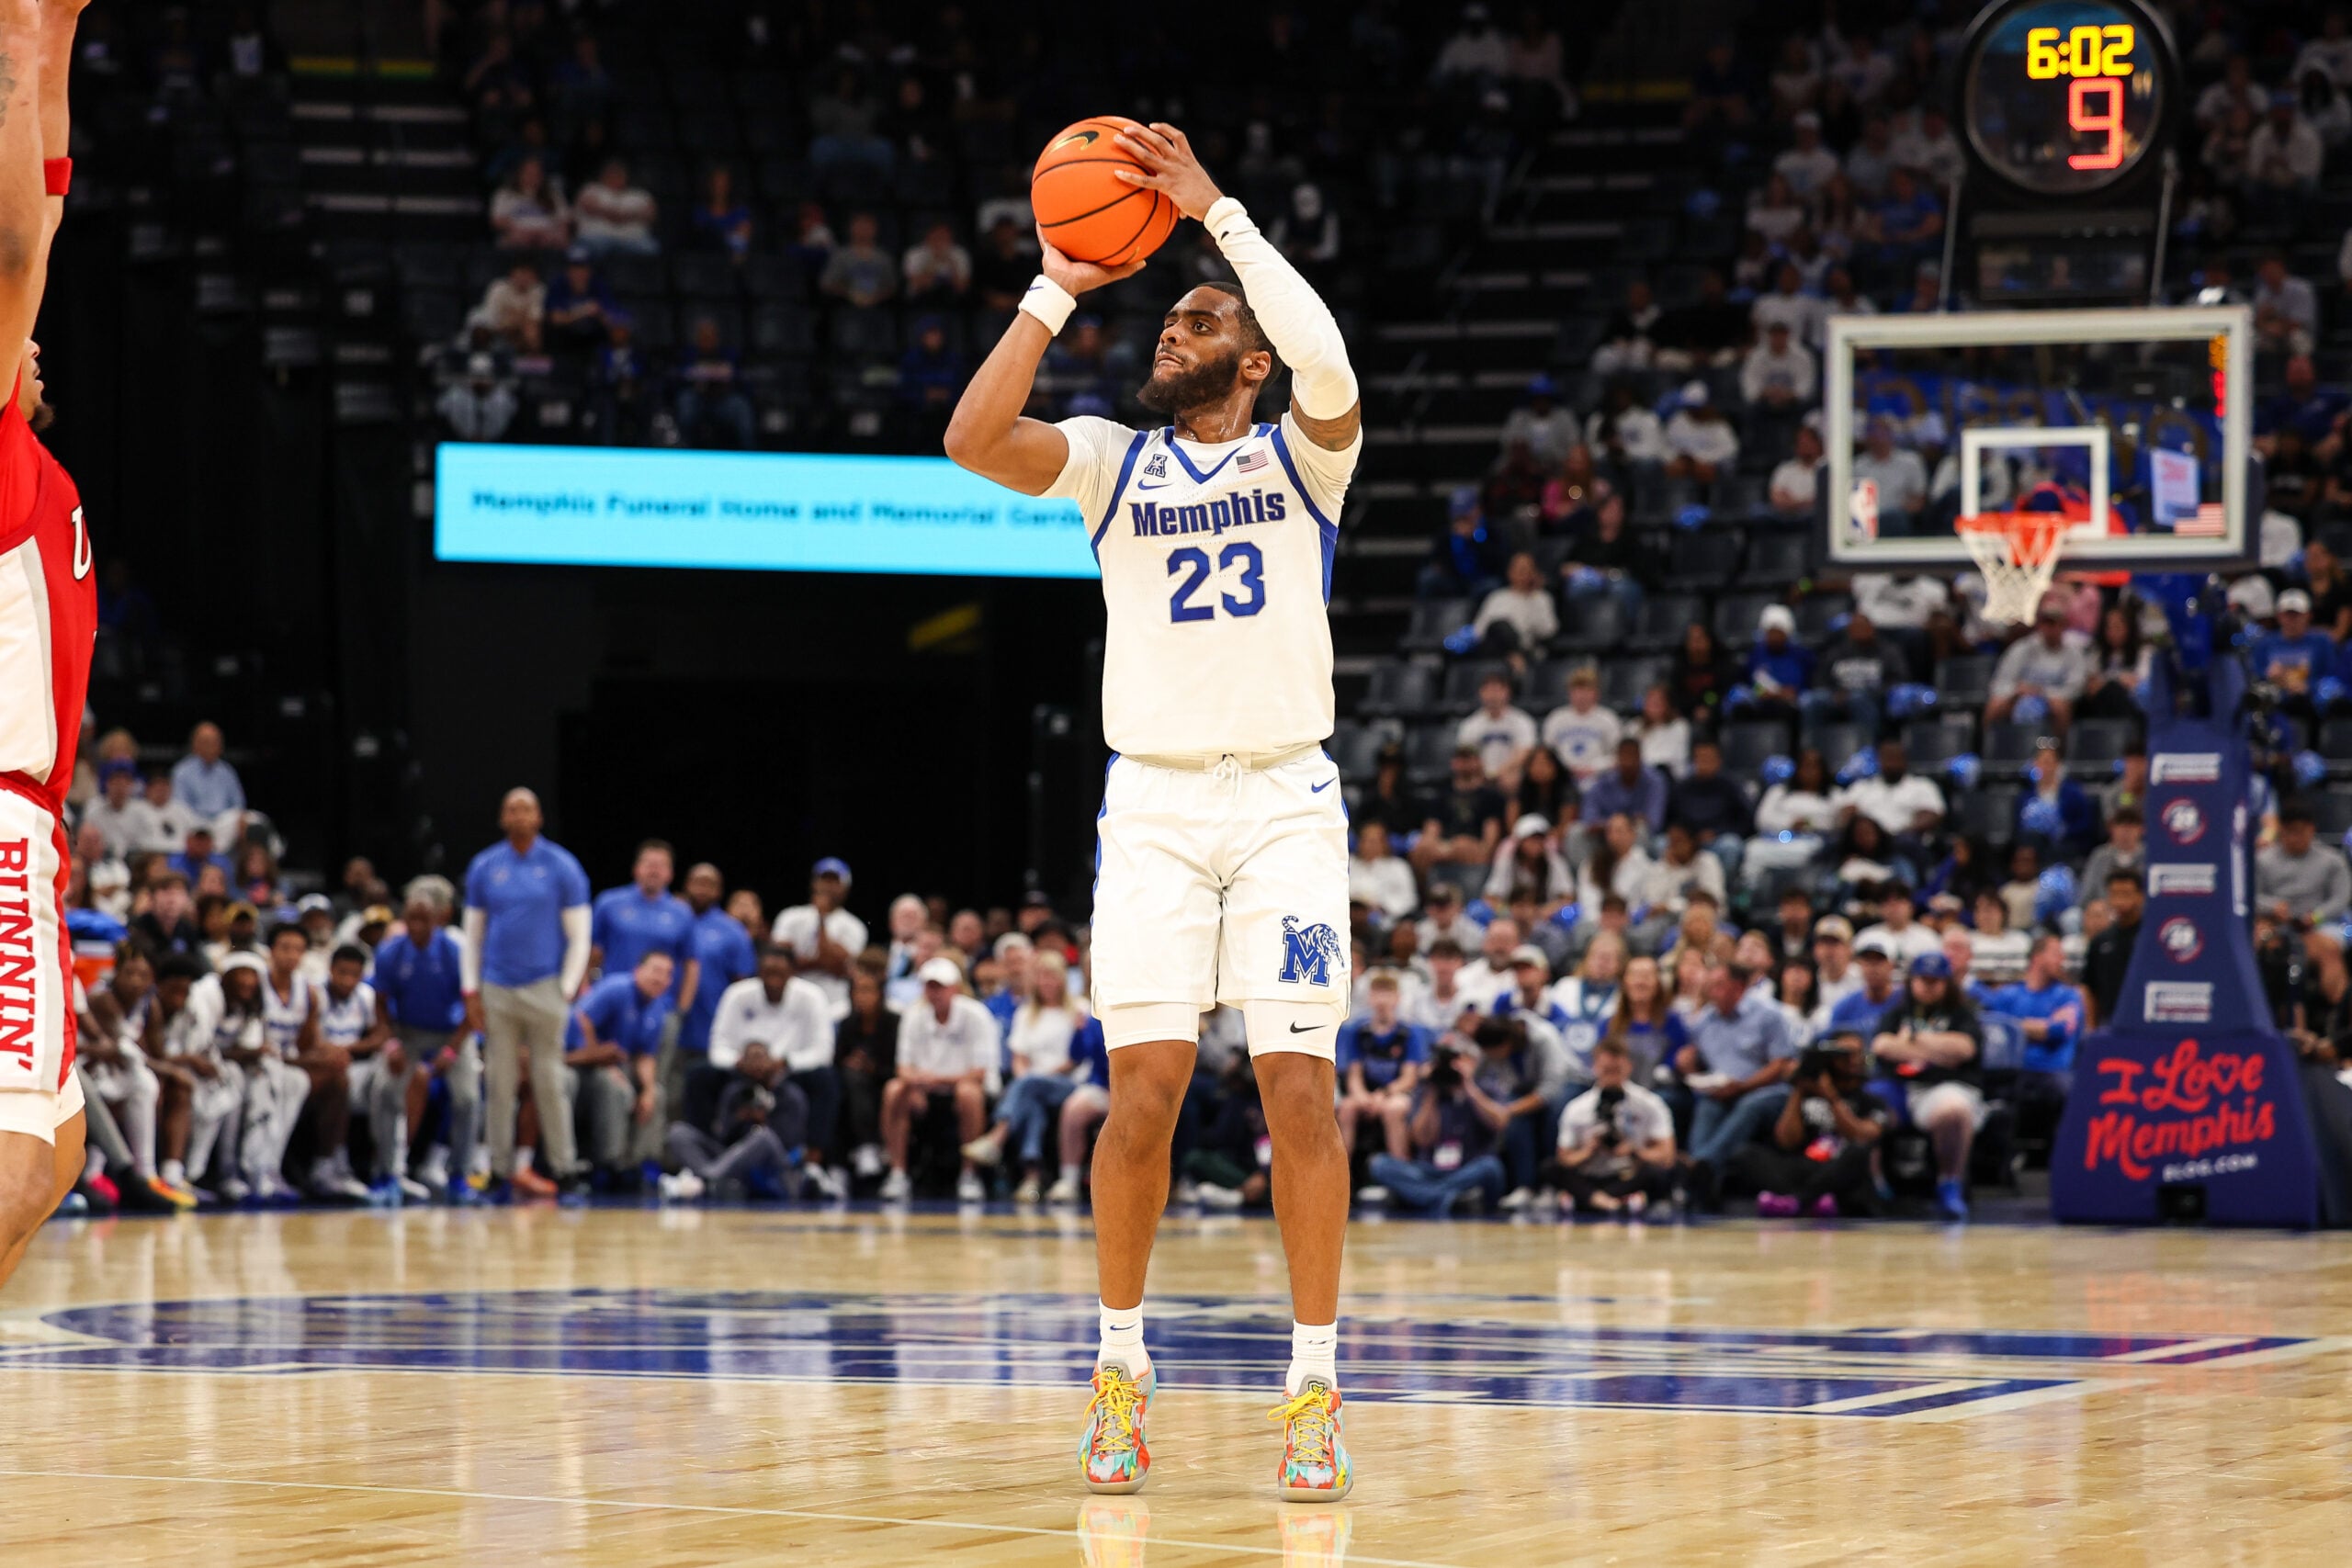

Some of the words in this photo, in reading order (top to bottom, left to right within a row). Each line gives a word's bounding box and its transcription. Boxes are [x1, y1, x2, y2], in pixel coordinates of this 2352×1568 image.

[2027, 24, 2135, 80] 6:02
[2068, 77, 2124, 170] 9
[471, 491, 596, 520] Memphis
[605, 493, 711, 519] Funeral
[719, 496, 800, 522] Home
[811, 499, 863, 522] and
[872, 501, 995, 525] Memorial
[1126, 489, 1286, 537] Memphis
[1167, 541, 1267, 625] 23
[2097, 1058, 2144, 1105] I
[2142, 1037, 2265, 1113] Love
[2084, 1098, 2275, 1181] Memphis
